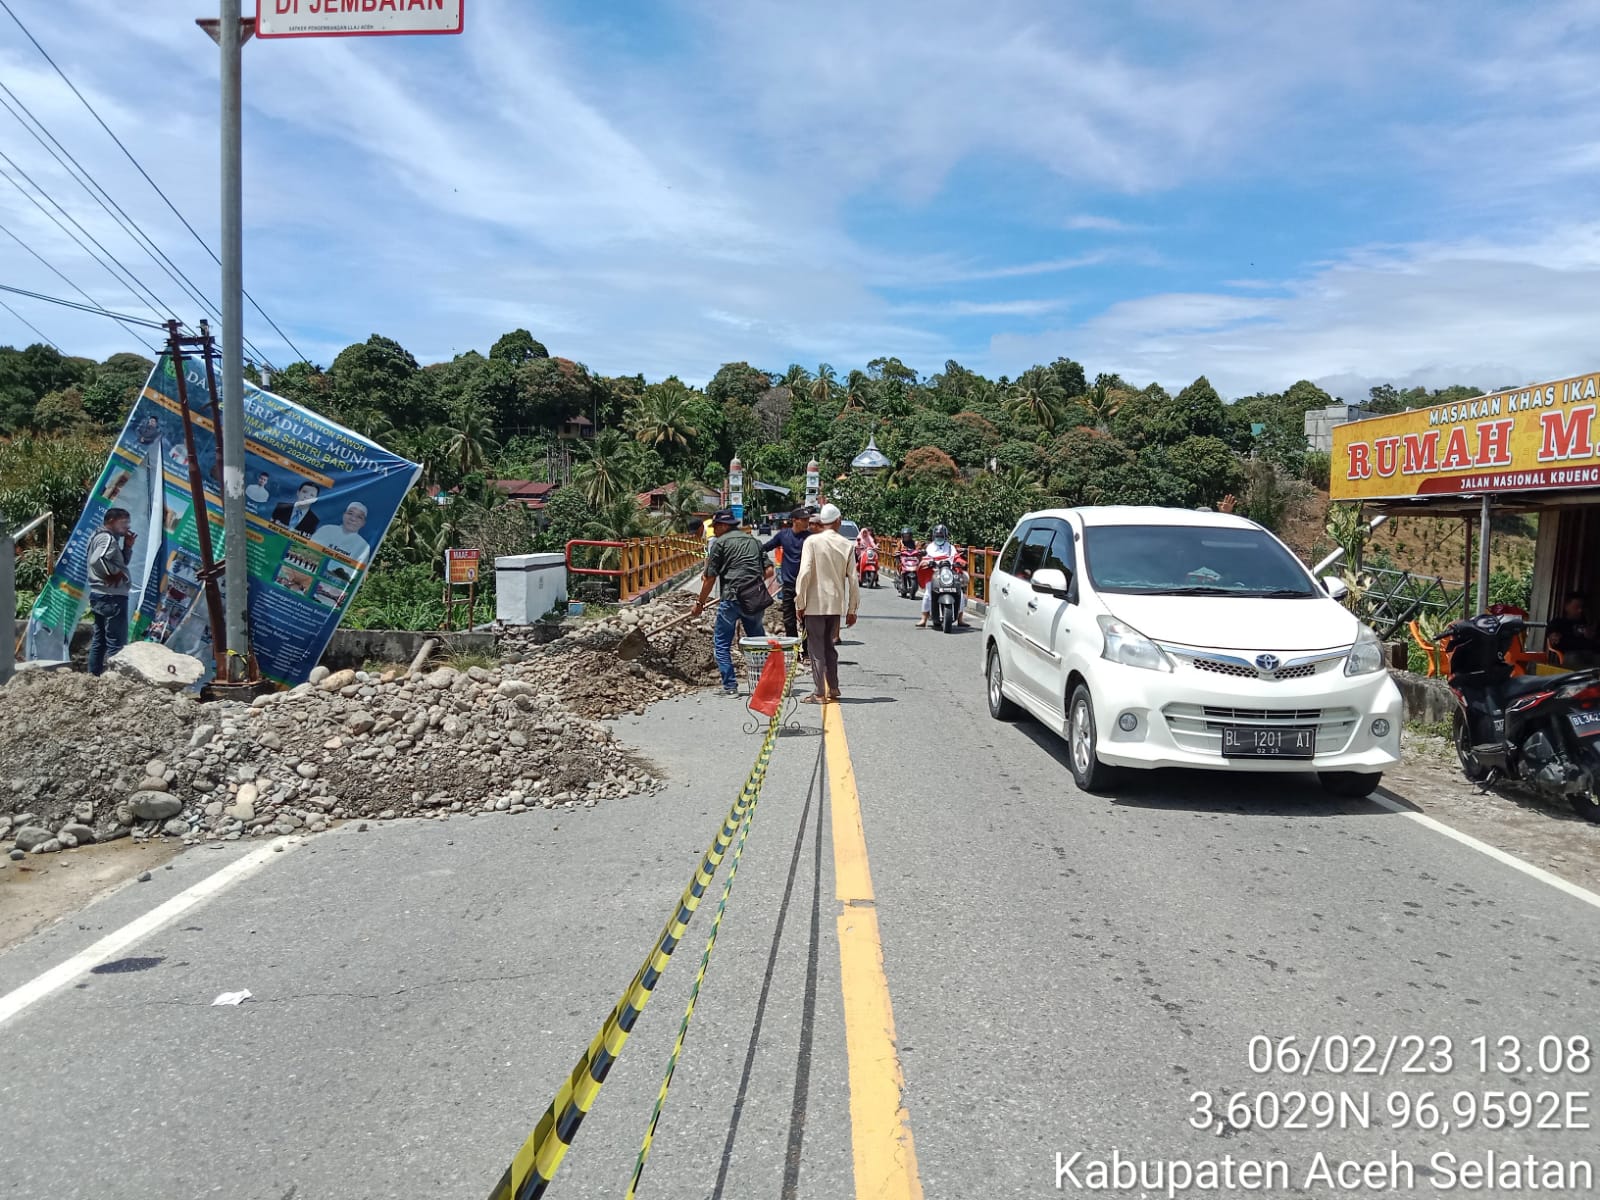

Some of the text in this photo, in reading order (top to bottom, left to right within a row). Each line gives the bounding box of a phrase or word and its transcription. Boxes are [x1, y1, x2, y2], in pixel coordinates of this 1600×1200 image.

[275, 0, 298, 15] DI
[1429, 378, 1600, 426] MASAKAN KHAS IKA
[302, 417, 337, 440] PANTON
[1346, 404, 1600, 480] RUMAH M
[254, 431, 287, 452] AJARAN
[287, 447, 326, 471] 2023/2024
[282, 430, 322, 460] SANTRI
[323, 453, 354, 474] BARU
[1460, 468, 1599, 490] JALAN NASIONAL KRUENG
[1226, 730, 1310, 747] BL 1201 AI
